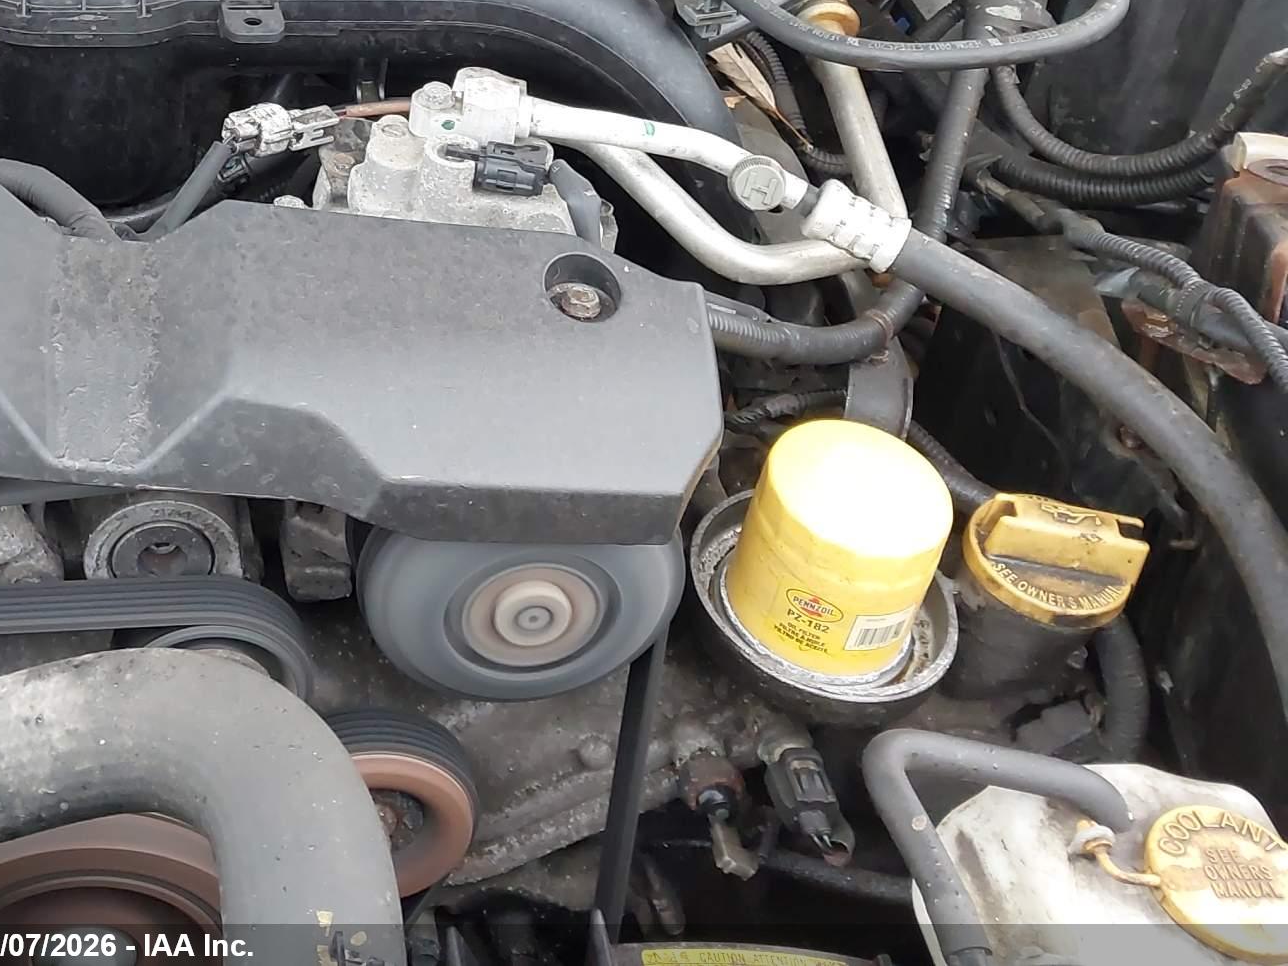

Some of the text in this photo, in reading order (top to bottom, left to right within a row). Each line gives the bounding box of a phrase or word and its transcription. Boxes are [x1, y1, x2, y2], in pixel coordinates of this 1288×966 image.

[741, 171, 779, 206] H
[996, 563, 1018, 584] SEE
[1079, 585, 1122, 610] MANUAL
[793, 596, 834, 616] PENNZOIL
[787, 608, 830, 634] PZ-182
[1158, 810, 1288, 855] COOLANT
[1205, 848, 1240, 864] SEE
[1210, 881, 1285, 900] MANUAL
[699, 951, 746, 964] CAUTION
